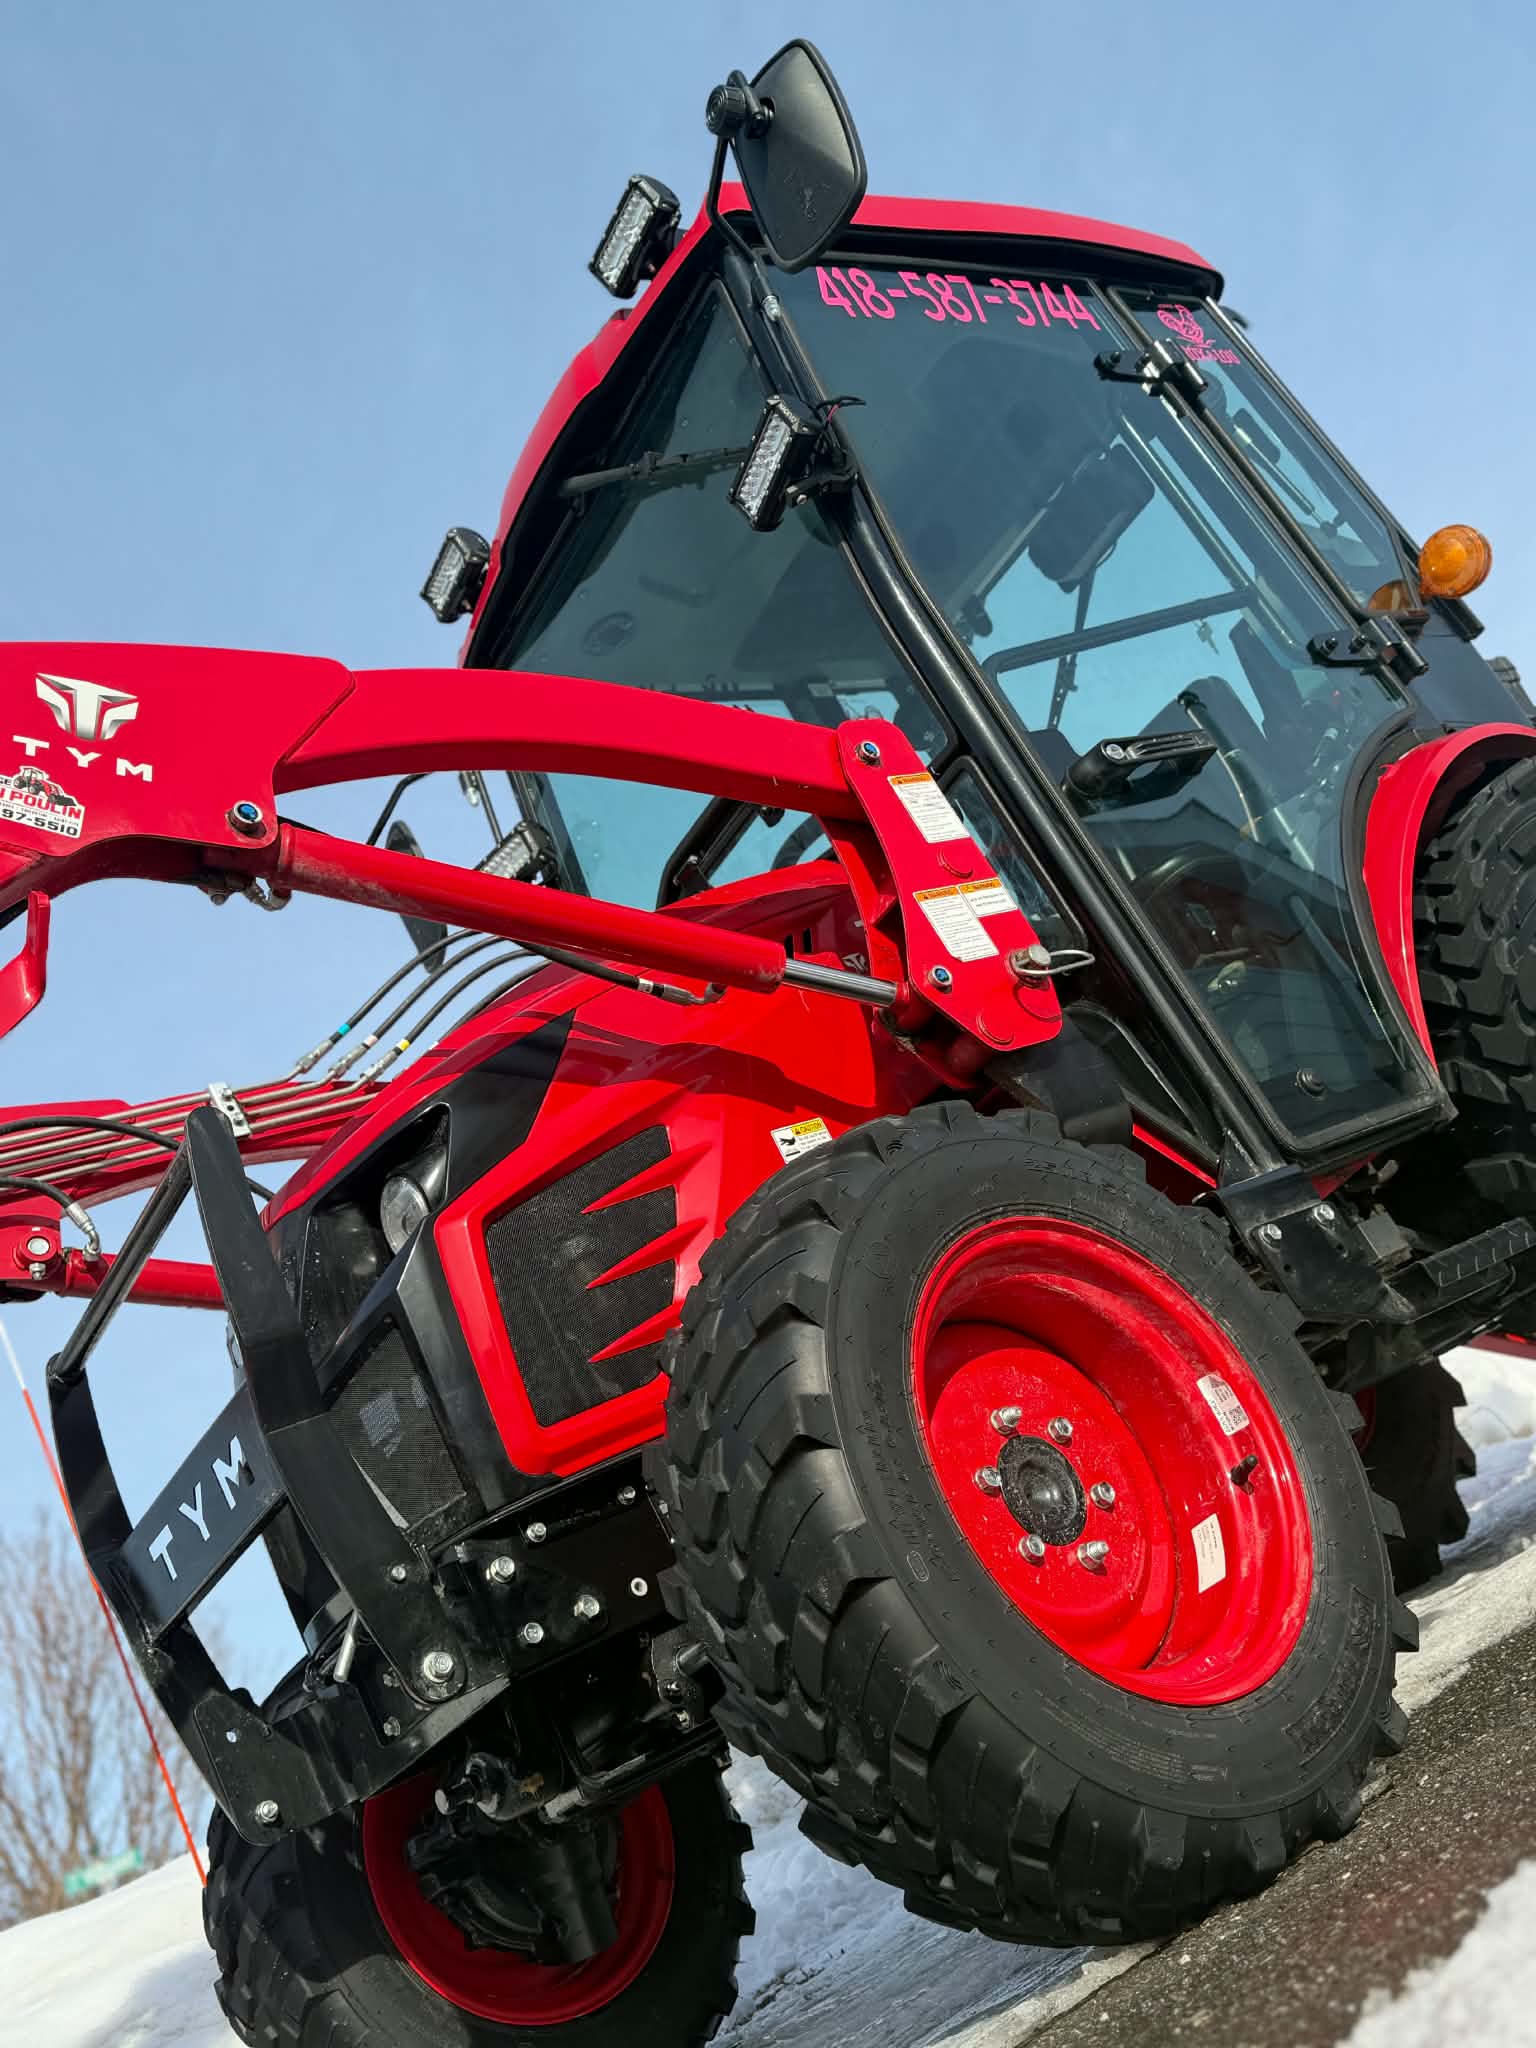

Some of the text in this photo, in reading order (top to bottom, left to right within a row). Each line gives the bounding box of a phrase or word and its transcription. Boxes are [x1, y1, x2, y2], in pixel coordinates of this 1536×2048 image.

[815, 266, 1101, 330] 418-587-3744
[12, 734, 153, 782] TYM
[9, 790, 82, 820] POULIN
[148, 1435, 255, 1582] TYM
